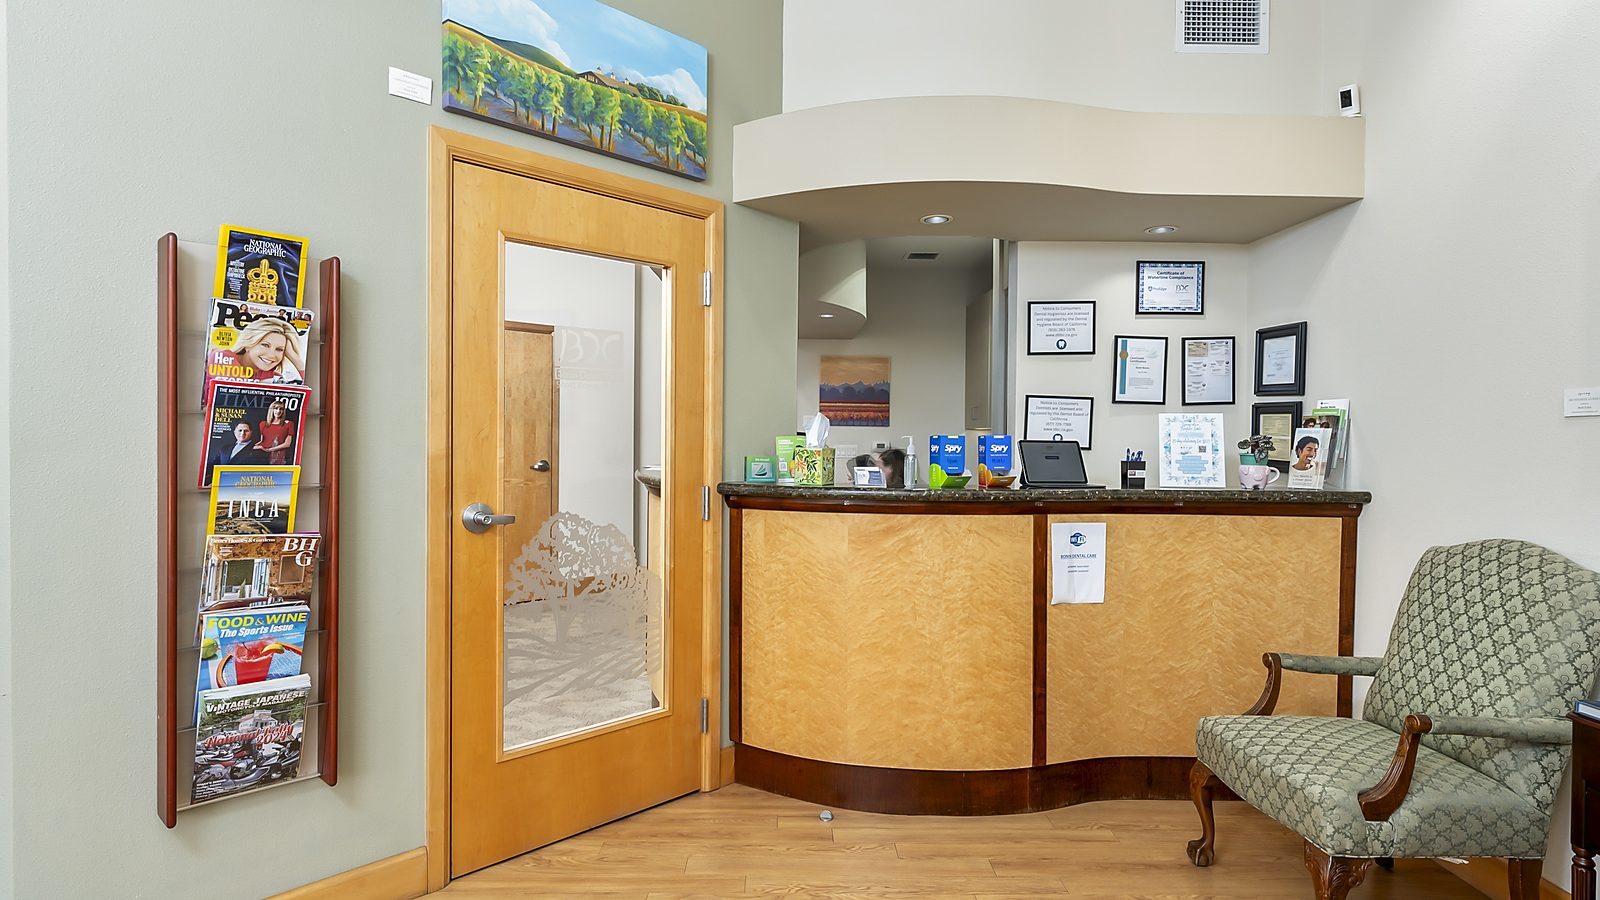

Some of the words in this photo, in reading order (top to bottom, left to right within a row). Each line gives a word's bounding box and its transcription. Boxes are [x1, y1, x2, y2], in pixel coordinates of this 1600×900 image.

[244, 244, 286, 258] GEOGRAPHIC
[250, 239, 283, 250] NATIONAL
[215, 352, 234, 365] Her
[209, 364, 254, 378] UNTOLD
[944, 444, 962, 453] Spry
[990, 444, 1008, 453] Spry
[228, 500, 279, 518] INCA
[282, 538, 318, 551] BH
[296, 551, 312, 566] G
[208, 616, 254, 630] FOOD
[255, 618, 264, 626] &
[266, 613, 308, 625] WINE
[220, 629, 237, 638] The
[238, 626, 269, 637] Sports
[270, 624, 294, 633] Issue
[206, 699, 251, 712] VINTAGE
[253, 690, 306, 704] JAPANESE
[204, 729, 261, 748] National
[261, 722, 294, 736] Rally
[256, 731, 288, 748] 2024
